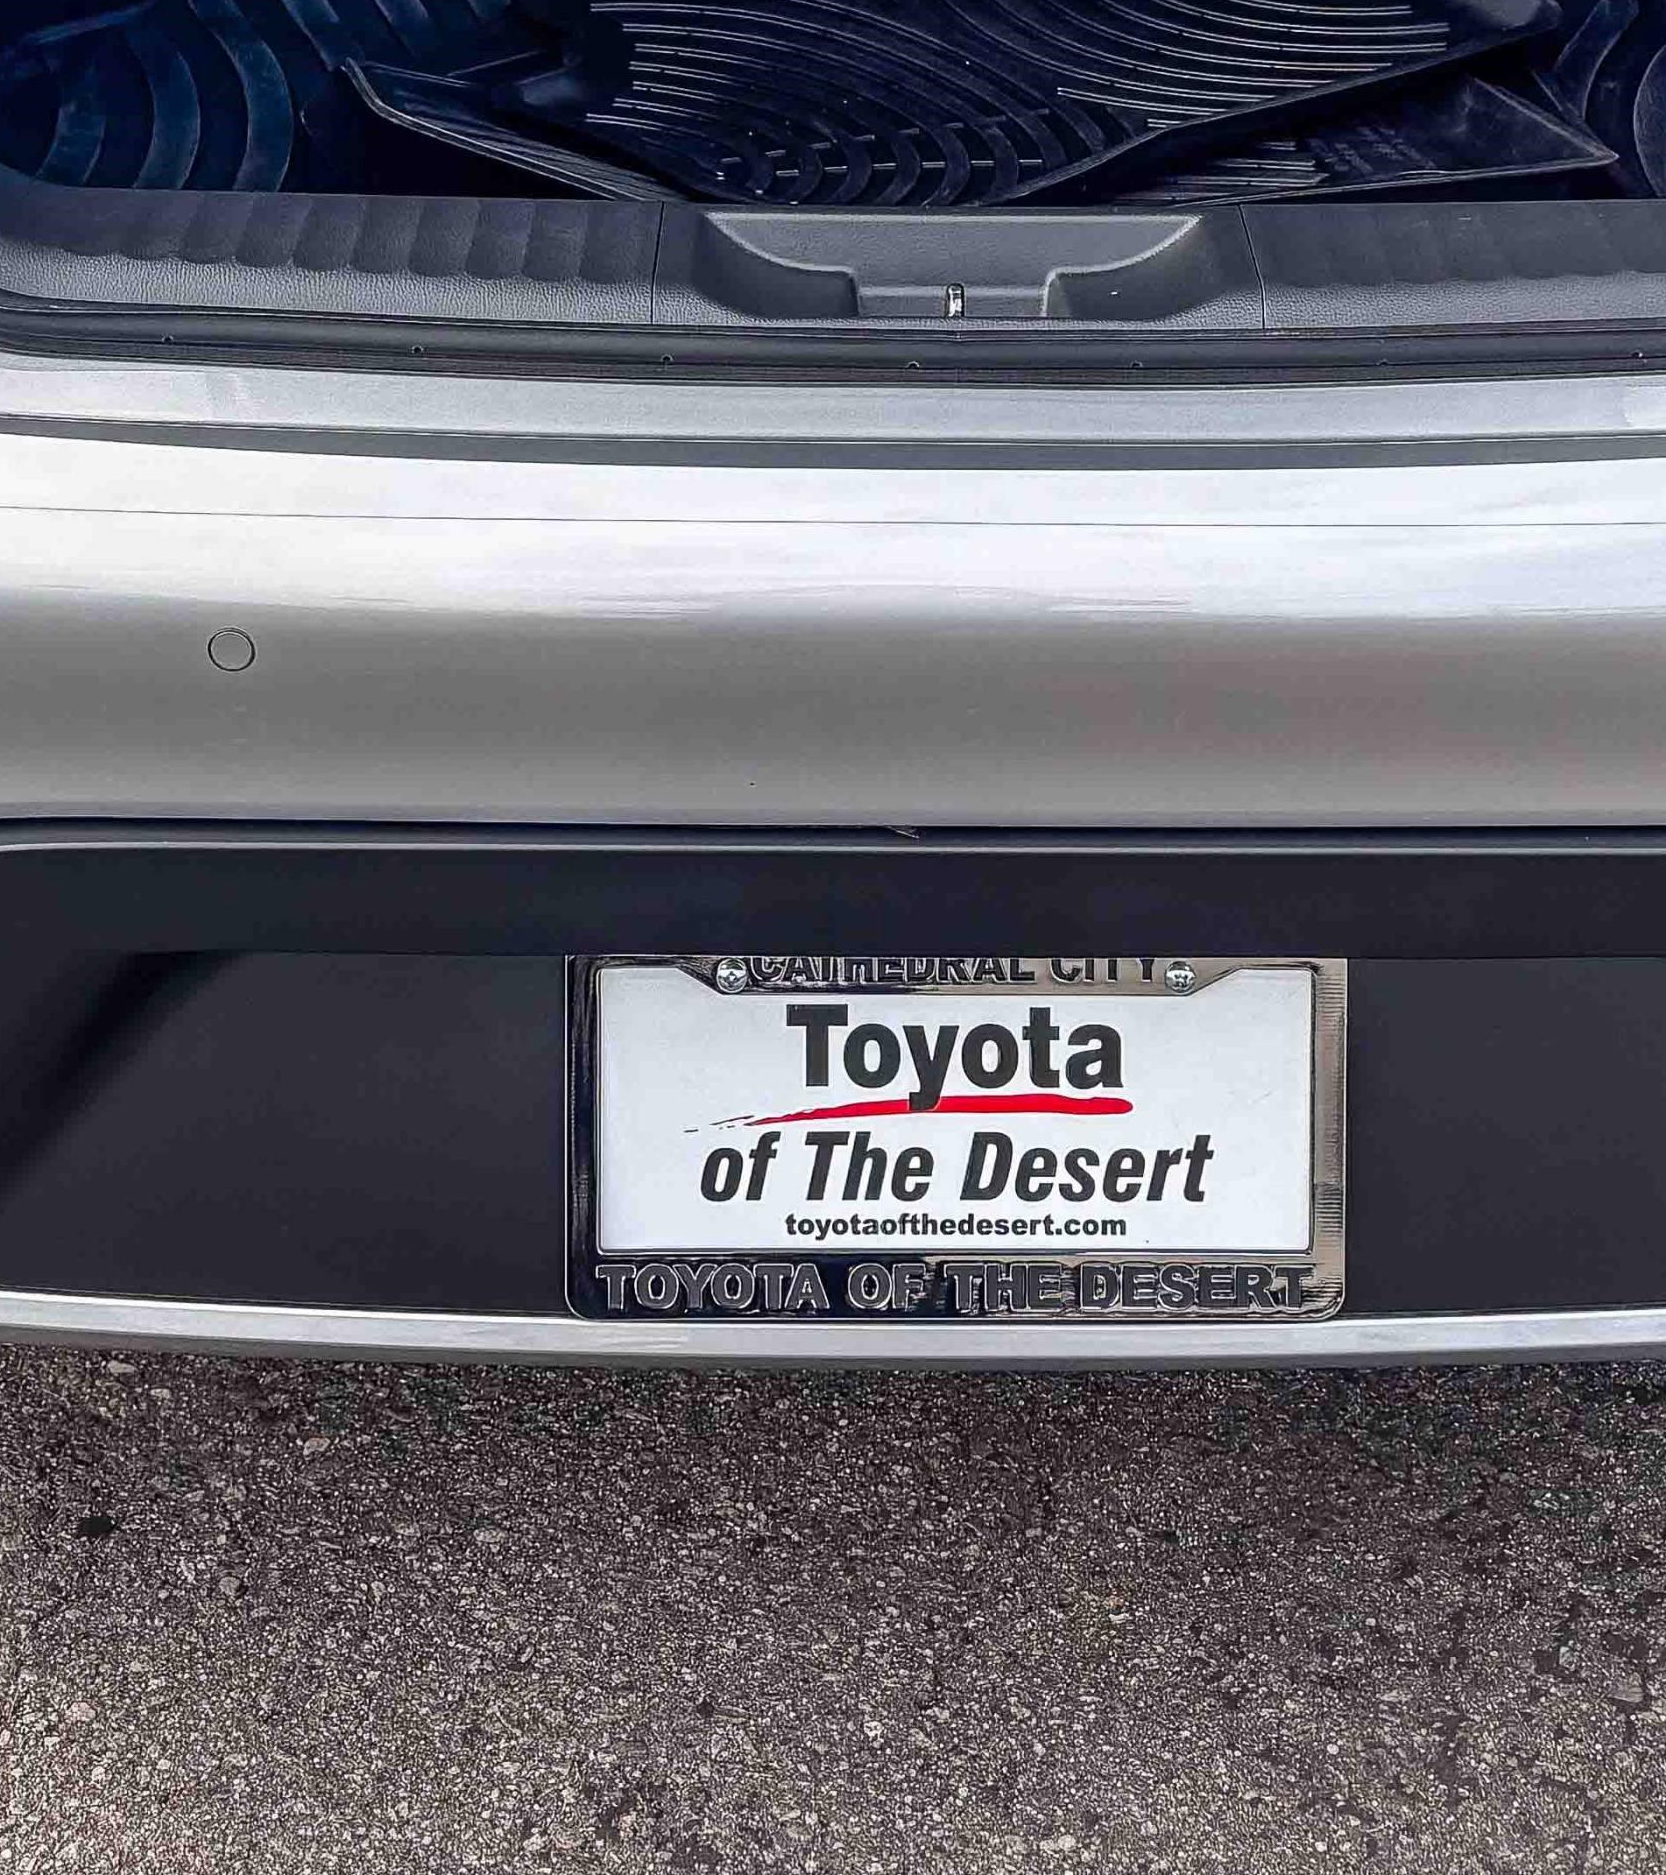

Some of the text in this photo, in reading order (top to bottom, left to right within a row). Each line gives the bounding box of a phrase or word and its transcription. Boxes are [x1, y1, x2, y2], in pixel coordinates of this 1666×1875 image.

[749, 956, 1159, 984] CATHEDRAL CITY
[786, 1003, 1124, 1111] Toyota
[699, 1131, 1215, 1202] of The Desert
[786, 1213, 1127, 1241] toyotaofthedesert.com
[595, 1262, 1310, 1311] TOYOTA OF THE DESERT
